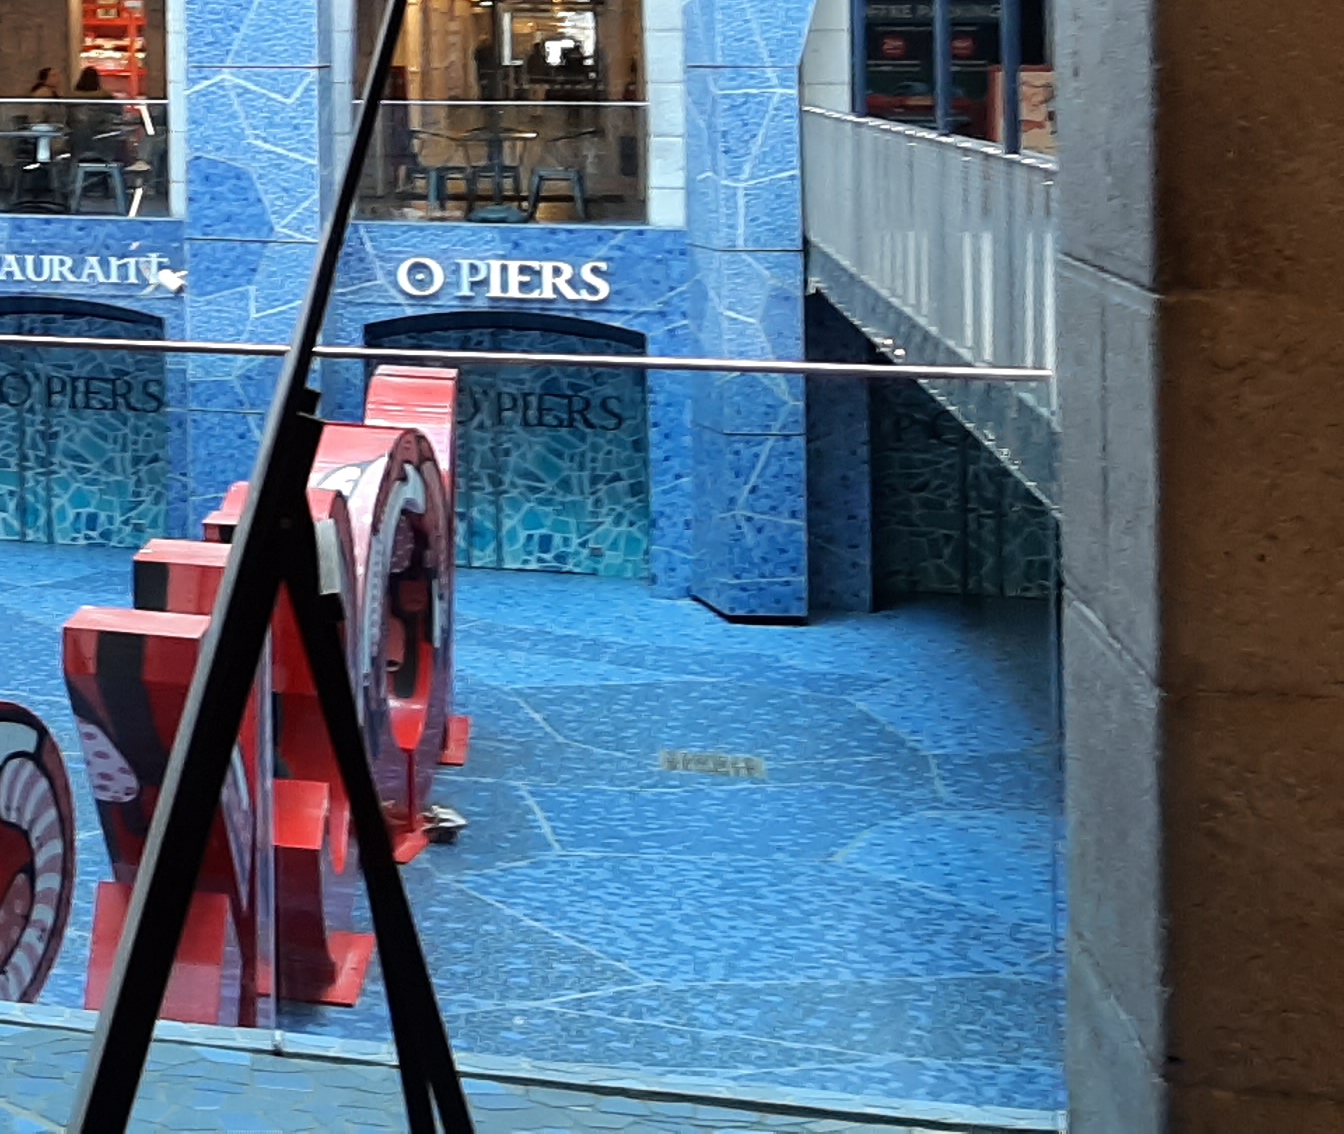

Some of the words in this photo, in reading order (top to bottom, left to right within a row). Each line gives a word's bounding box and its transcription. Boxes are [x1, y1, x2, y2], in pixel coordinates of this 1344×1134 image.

[396, 257, 445, 297] O
[454, 259, 611, 302] PIERS
[46, 374, 164, 413] PIERS
[496, 391, 625, 431] PIERS
